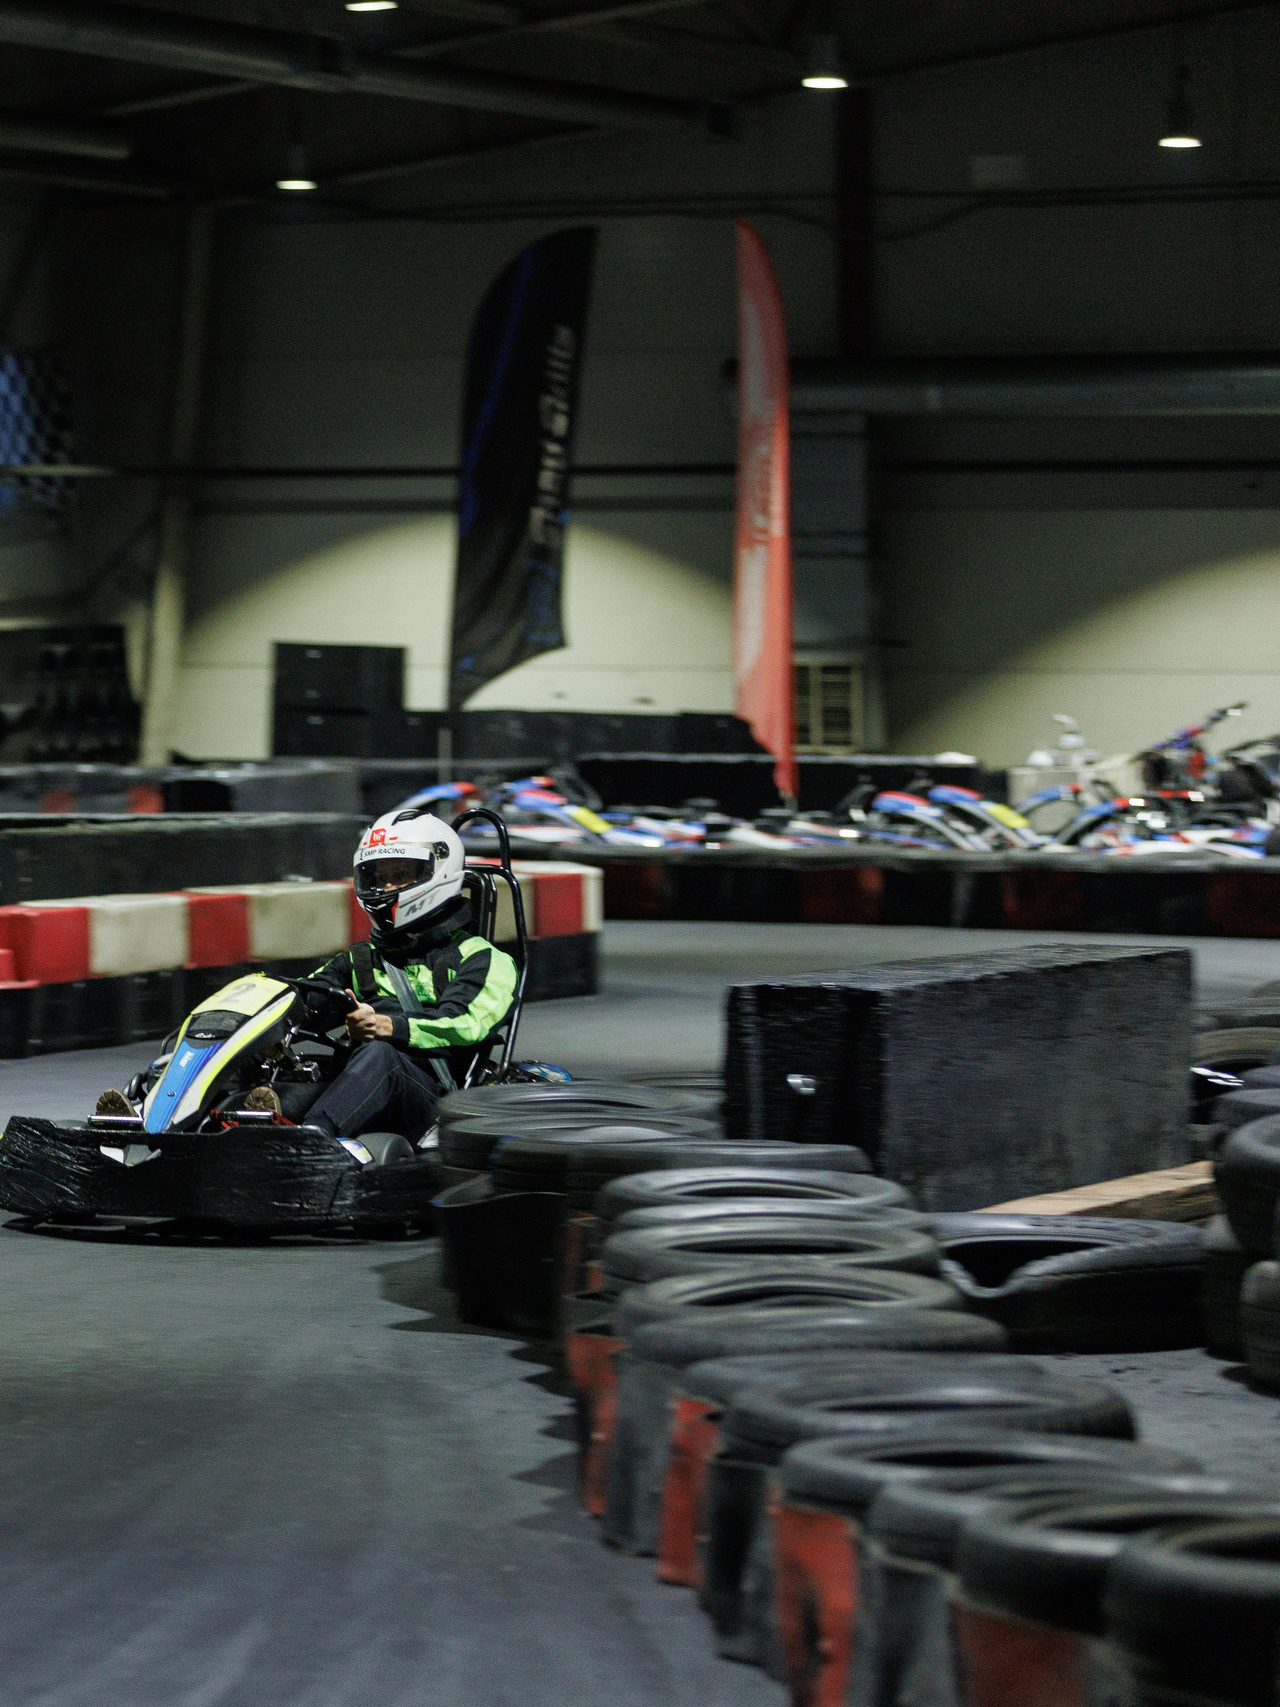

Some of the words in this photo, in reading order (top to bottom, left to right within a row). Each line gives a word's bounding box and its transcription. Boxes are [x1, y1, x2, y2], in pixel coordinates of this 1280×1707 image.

[363, 849, 377, 857] SMP
[377, 847, 406, 855] RACING
[218, 982, 256, 1003] 2
